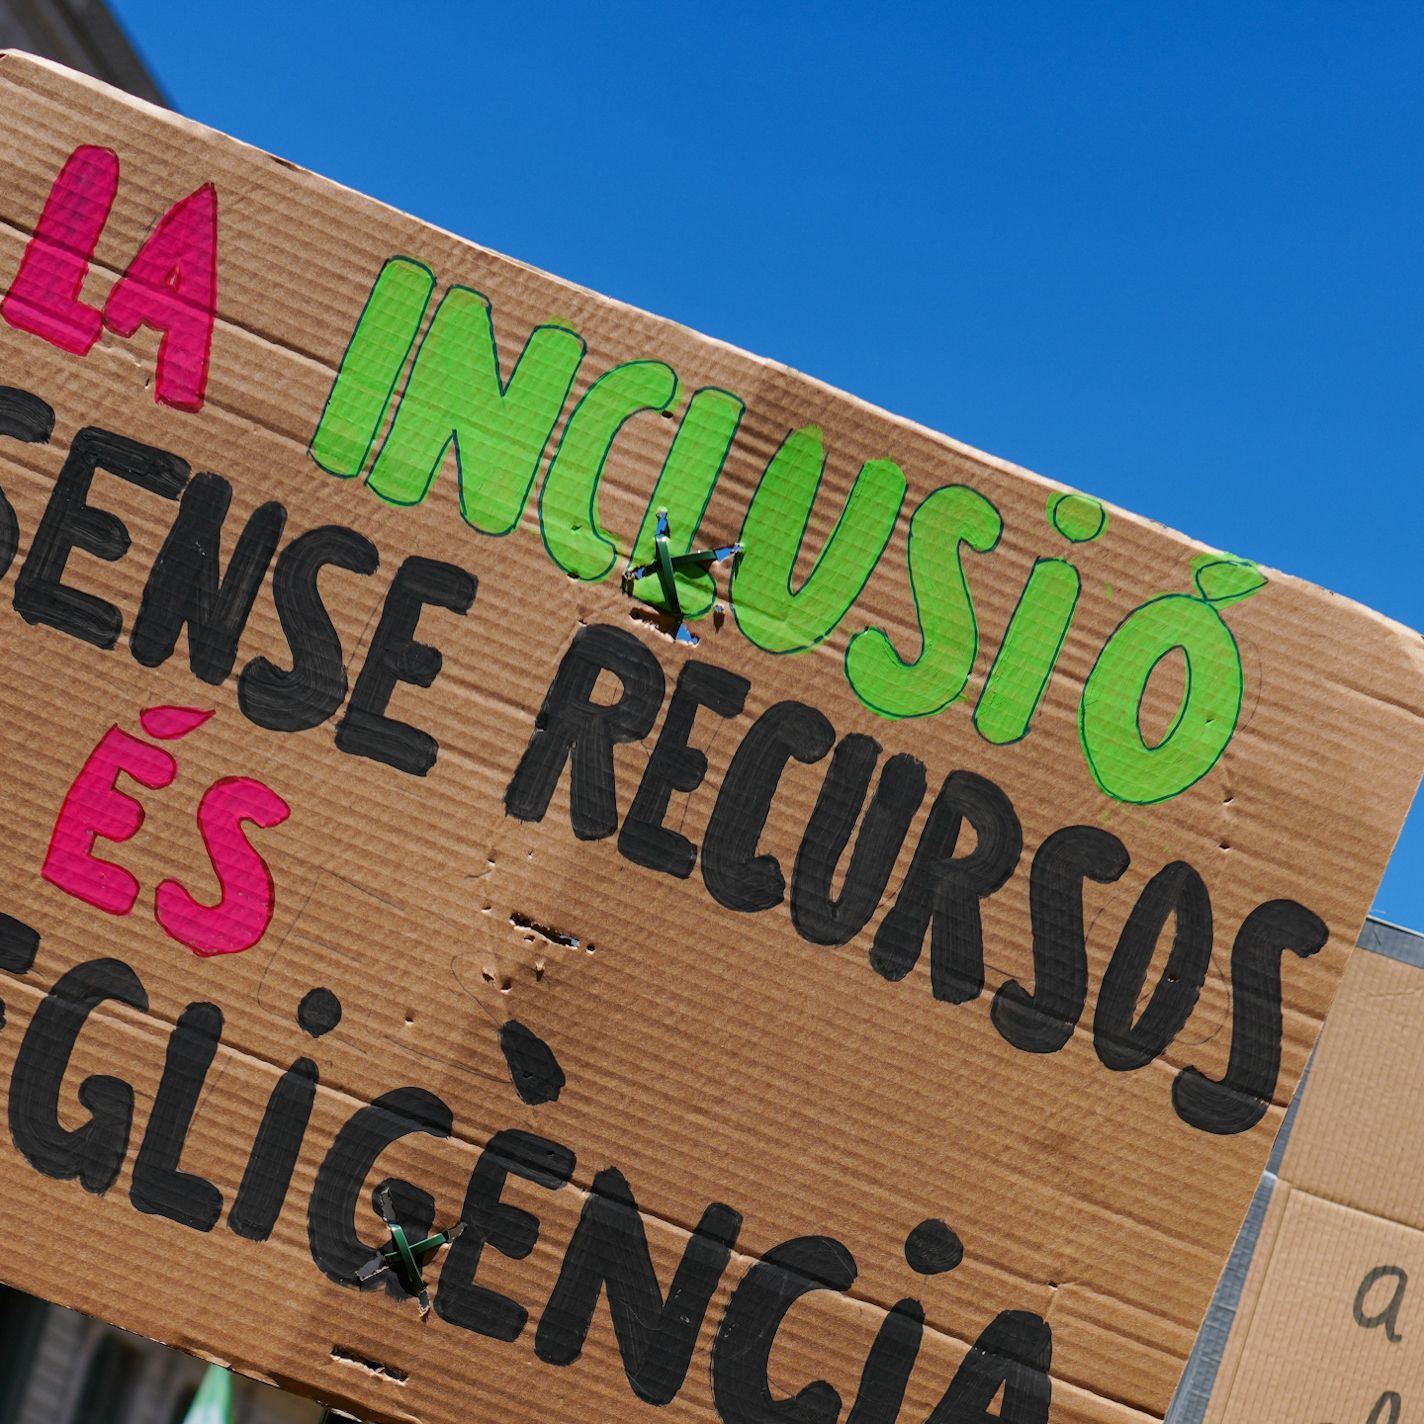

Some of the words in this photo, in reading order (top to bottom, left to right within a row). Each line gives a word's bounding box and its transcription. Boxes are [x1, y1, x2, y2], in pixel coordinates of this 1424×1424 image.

[0, 145, 218, 413] LA
[41, 705, 291, 957] ÉS
[504, 624, 1331, 1135] RECURSOS
[1352, 1264, 1409, 1343] a
